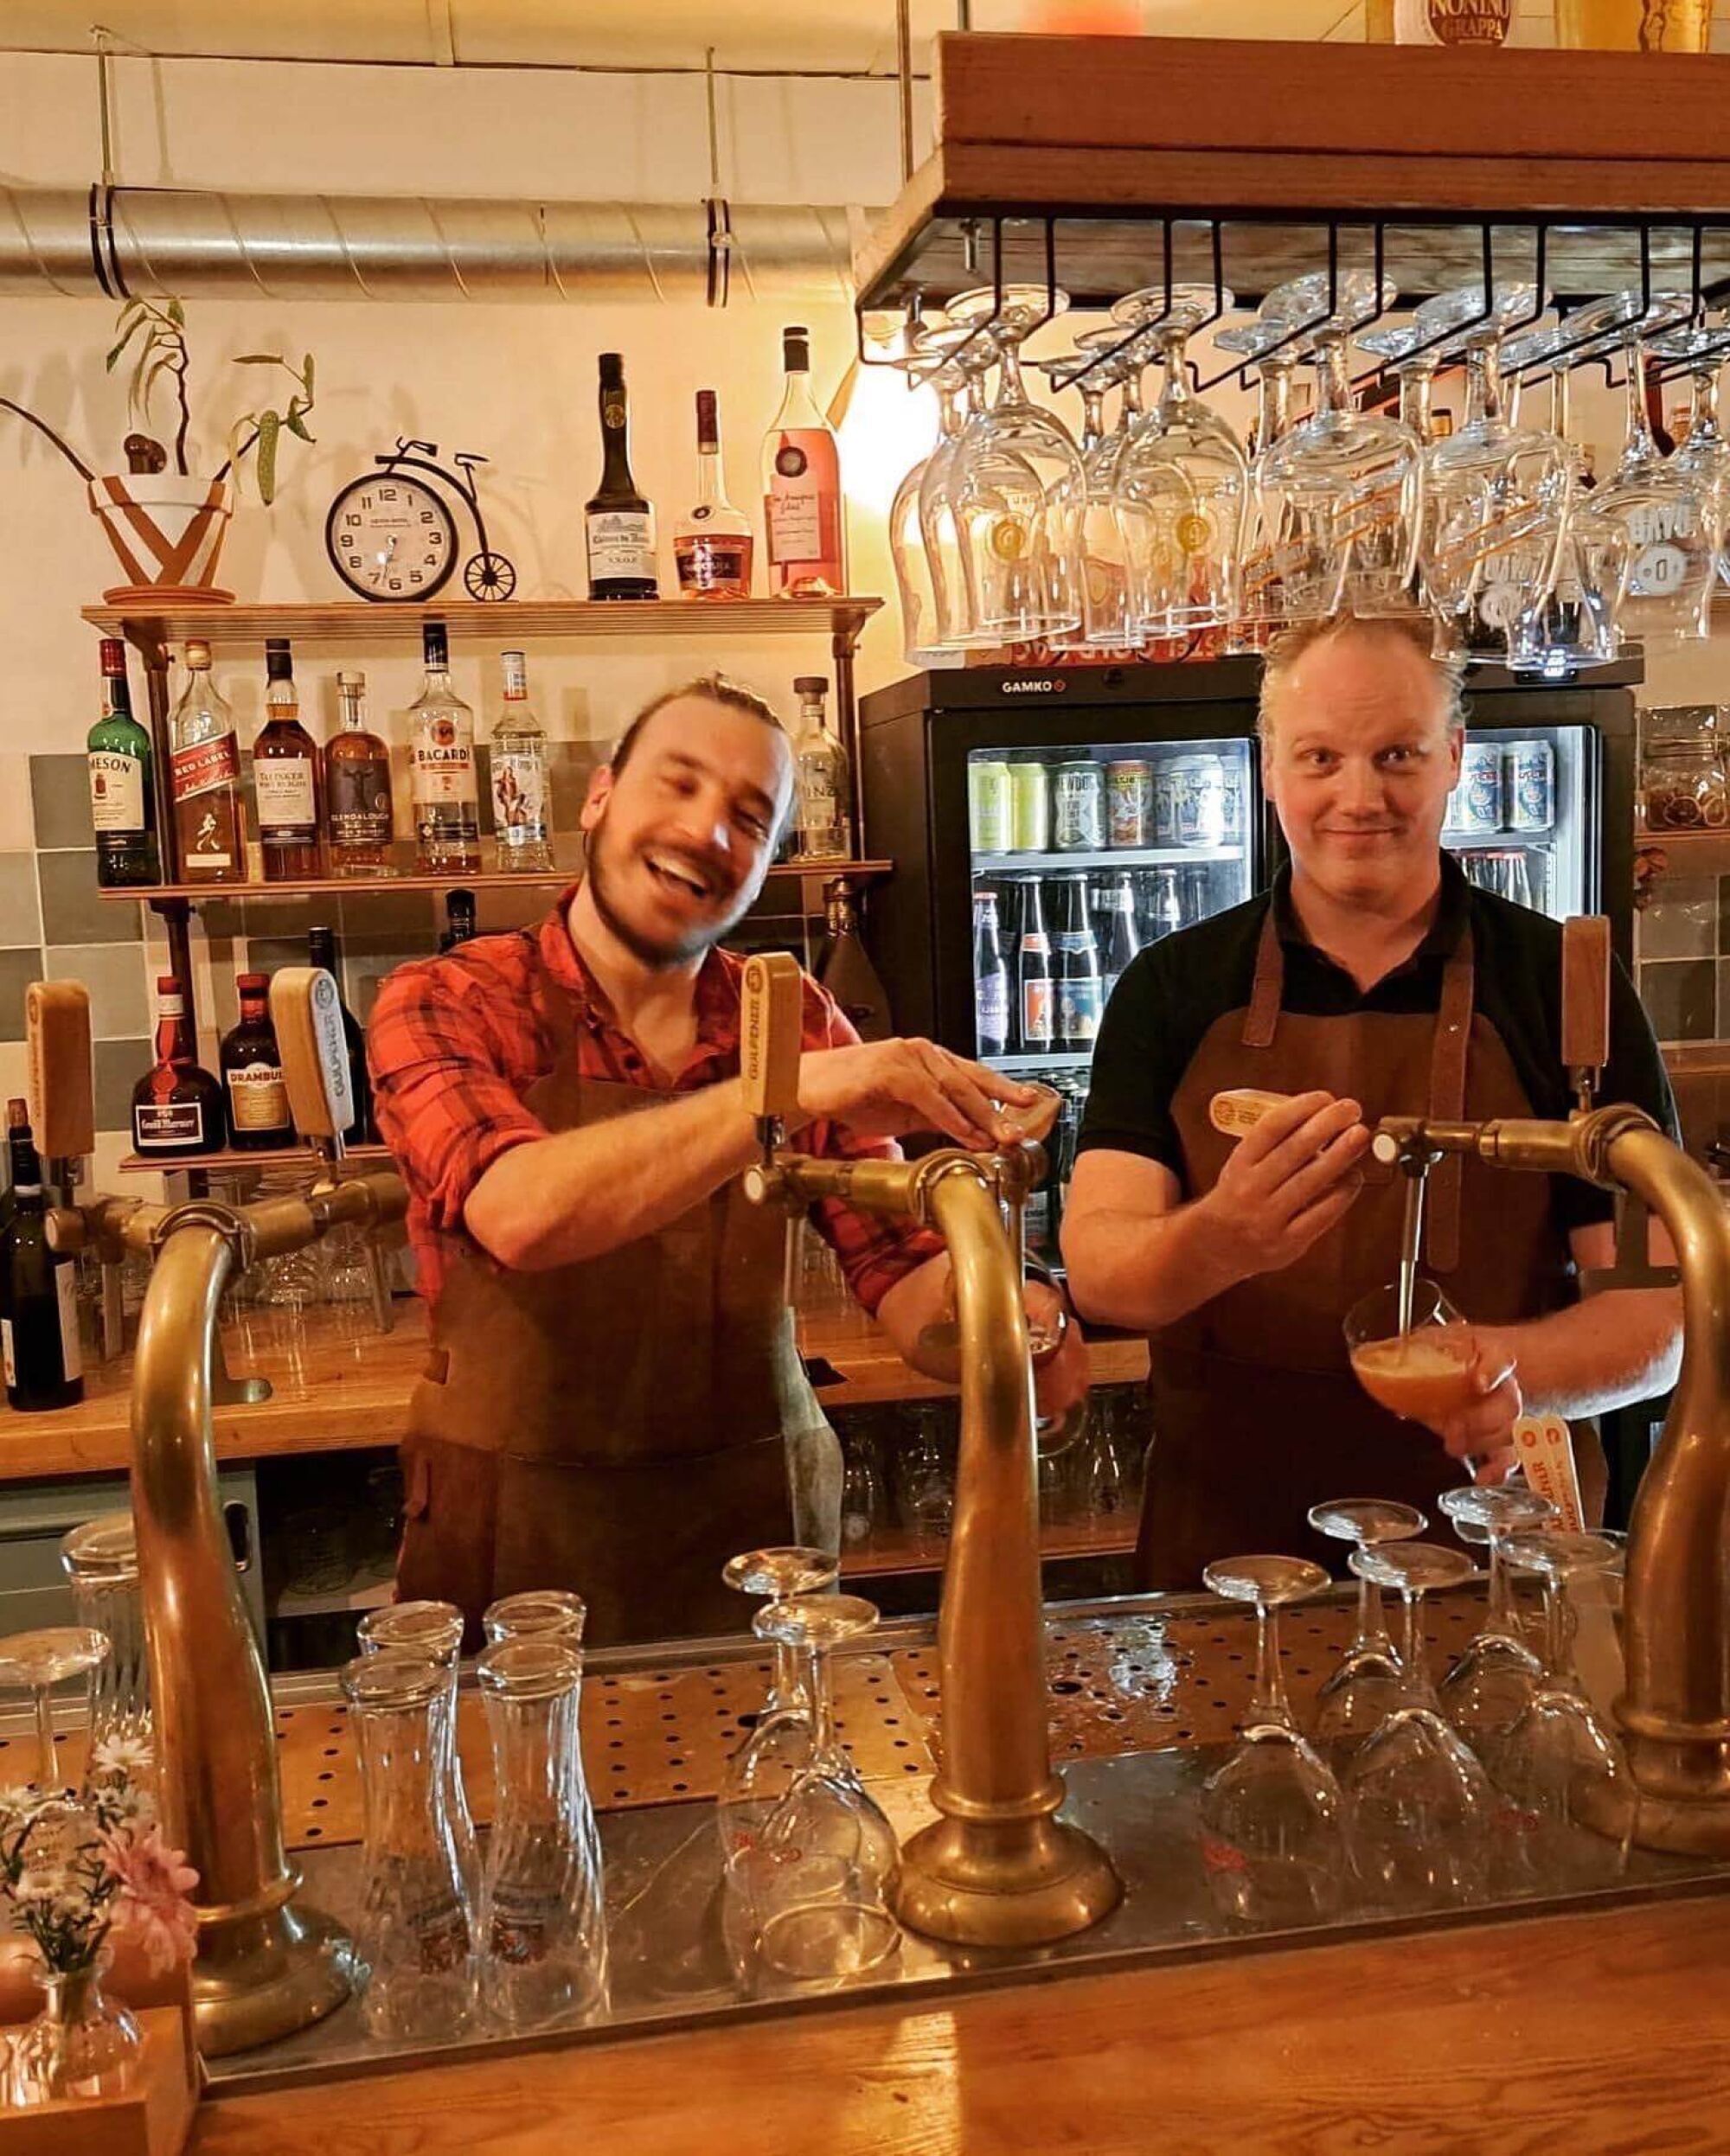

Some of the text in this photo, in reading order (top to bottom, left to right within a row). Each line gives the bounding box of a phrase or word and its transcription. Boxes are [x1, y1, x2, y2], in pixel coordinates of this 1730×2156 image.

[1441, 17, 1503, 39] GRAPPA
[379, 489, 397, 501] 12
[407, 494, 413, 506] 1
[362, 496, 372, 509] 11
[345, 515, 362, 526] 10
[420, 511, 433, 524] 2
[340, 534, 354, 547] 9
[429, 532, 442, 545] 3
[349, 555, 362, 568] 8
[424, 554, 436, 566] 4
[368, 573, 381, 585] 7
[410, 570, 423, 583] 5
[389, 578, 402, 590] 6
[1002, 681, 1053, 693] GAMKO
[418, 750, 470, 761] BACARDI
[174, 751, 231, 776] RED LABEL
